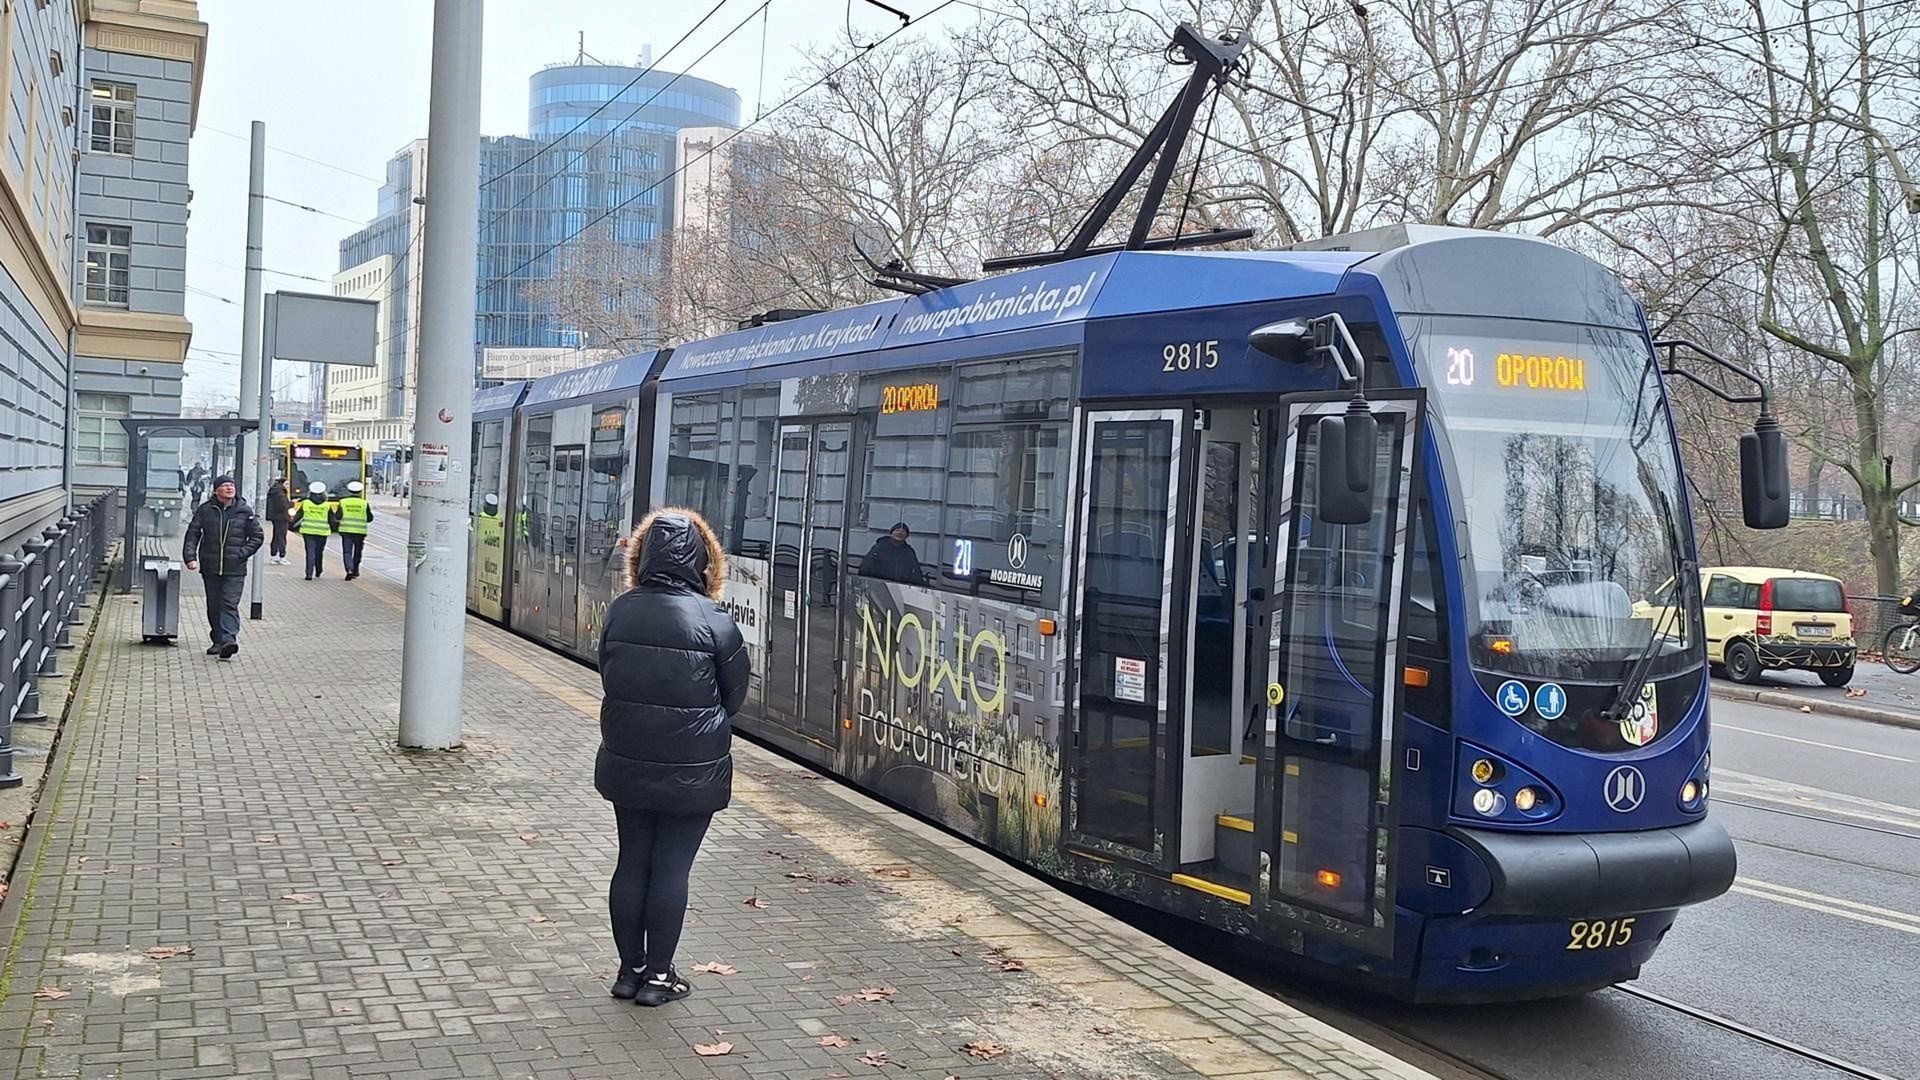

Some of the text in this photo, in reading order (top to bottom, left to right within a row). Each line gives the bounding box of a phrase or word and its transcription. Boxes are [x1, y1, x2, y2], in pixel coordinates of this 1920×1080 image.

[898, 271, 1097, 337] nowapabianicka.pl
[487, 352, 508, 361] Biuro
[509, 353, 519, 361] do
[678, 348, 736, 370] Nowoczesne
[734, 331, 796, 361] mieszkania
[797, 334, 811, 350] na
[1162, 340, 1219, 372] 2815
[1446, 347, 1584, 390] 20 OPORÓW
[883, 383, 938, 414] 20 OPORÓW
[953, 539, 972, 576] 20
[990, 568, 1042, 588] MODERTRANS
[859, 688, 1003, 794] Pabianicka
[1566, 918, 1636, 950] 2815
